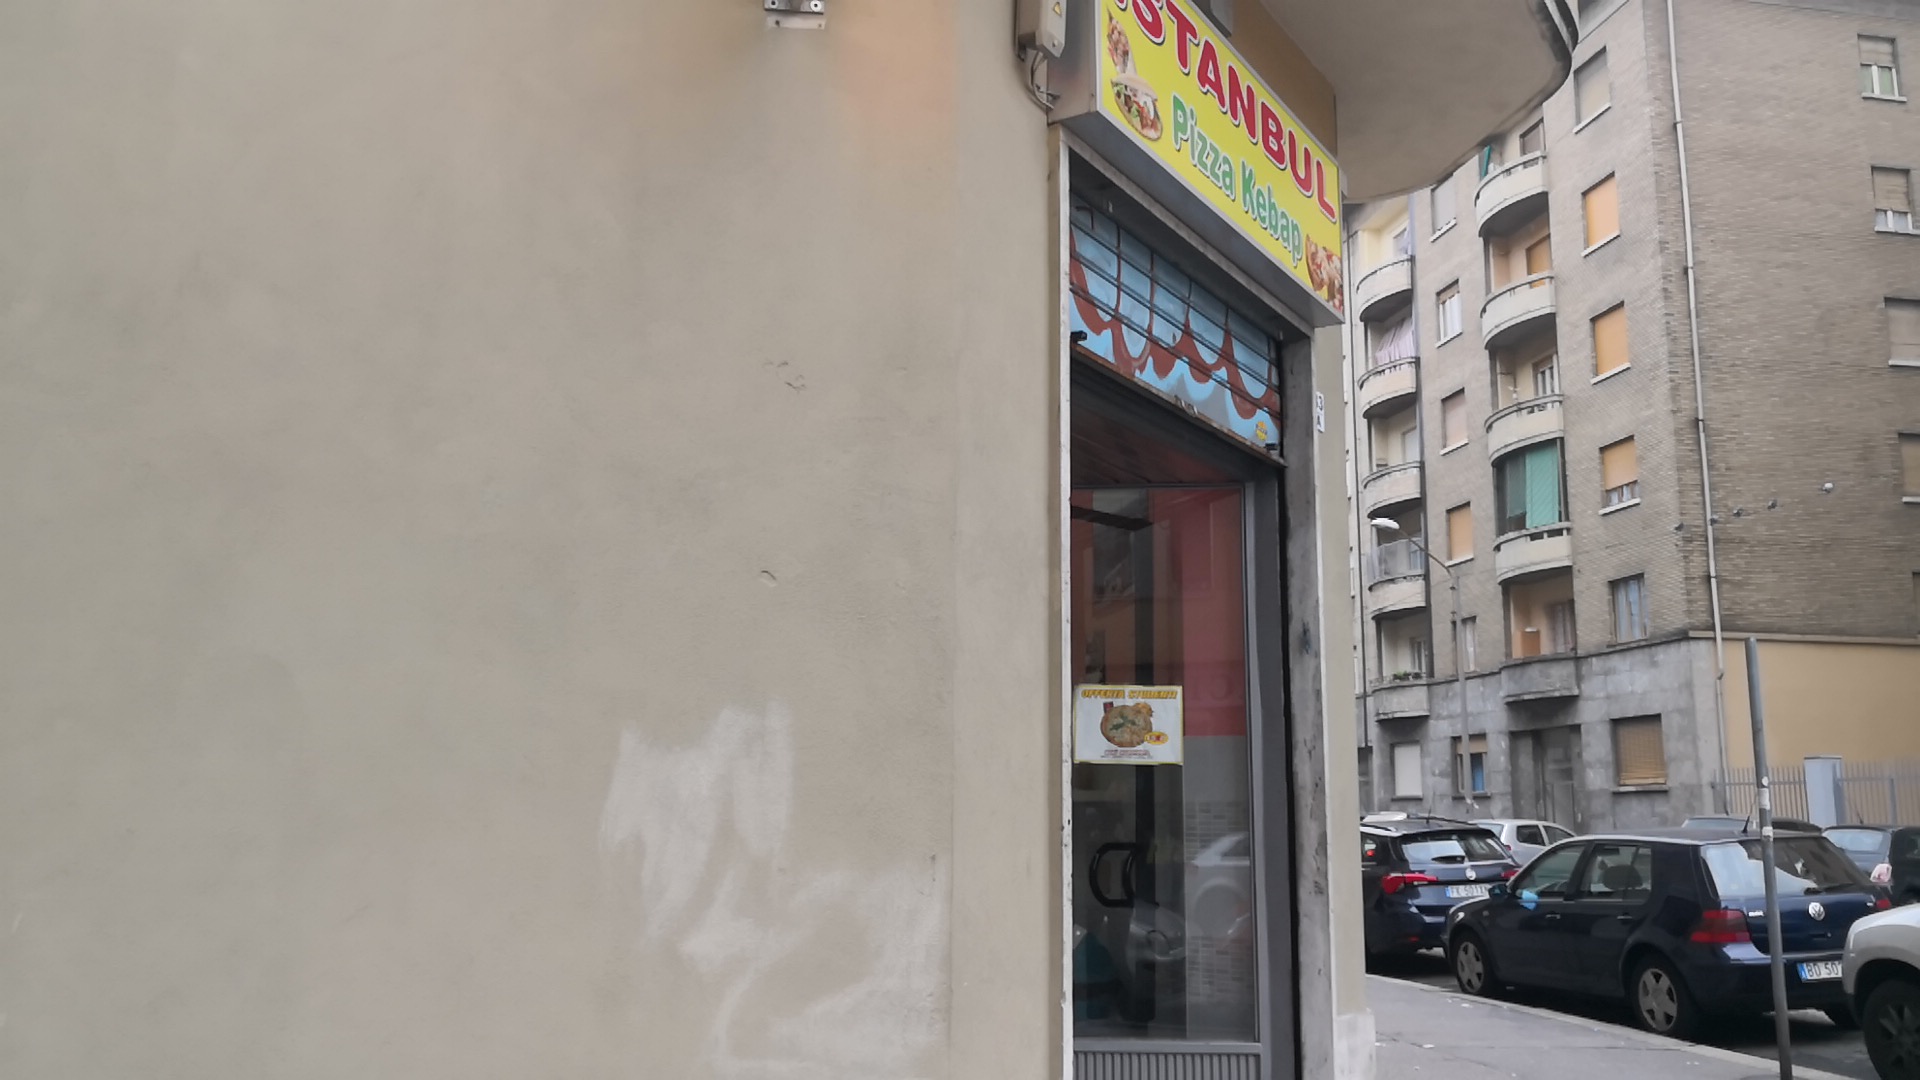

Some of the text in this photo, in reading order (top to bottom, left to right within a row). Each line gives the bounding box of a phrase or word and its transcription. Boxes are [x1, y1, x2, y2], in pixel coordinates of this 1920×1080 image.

[1114, 0, 1337, 223] STANBUL
[1172, 94, 1303, 267] Pizza Kebap
